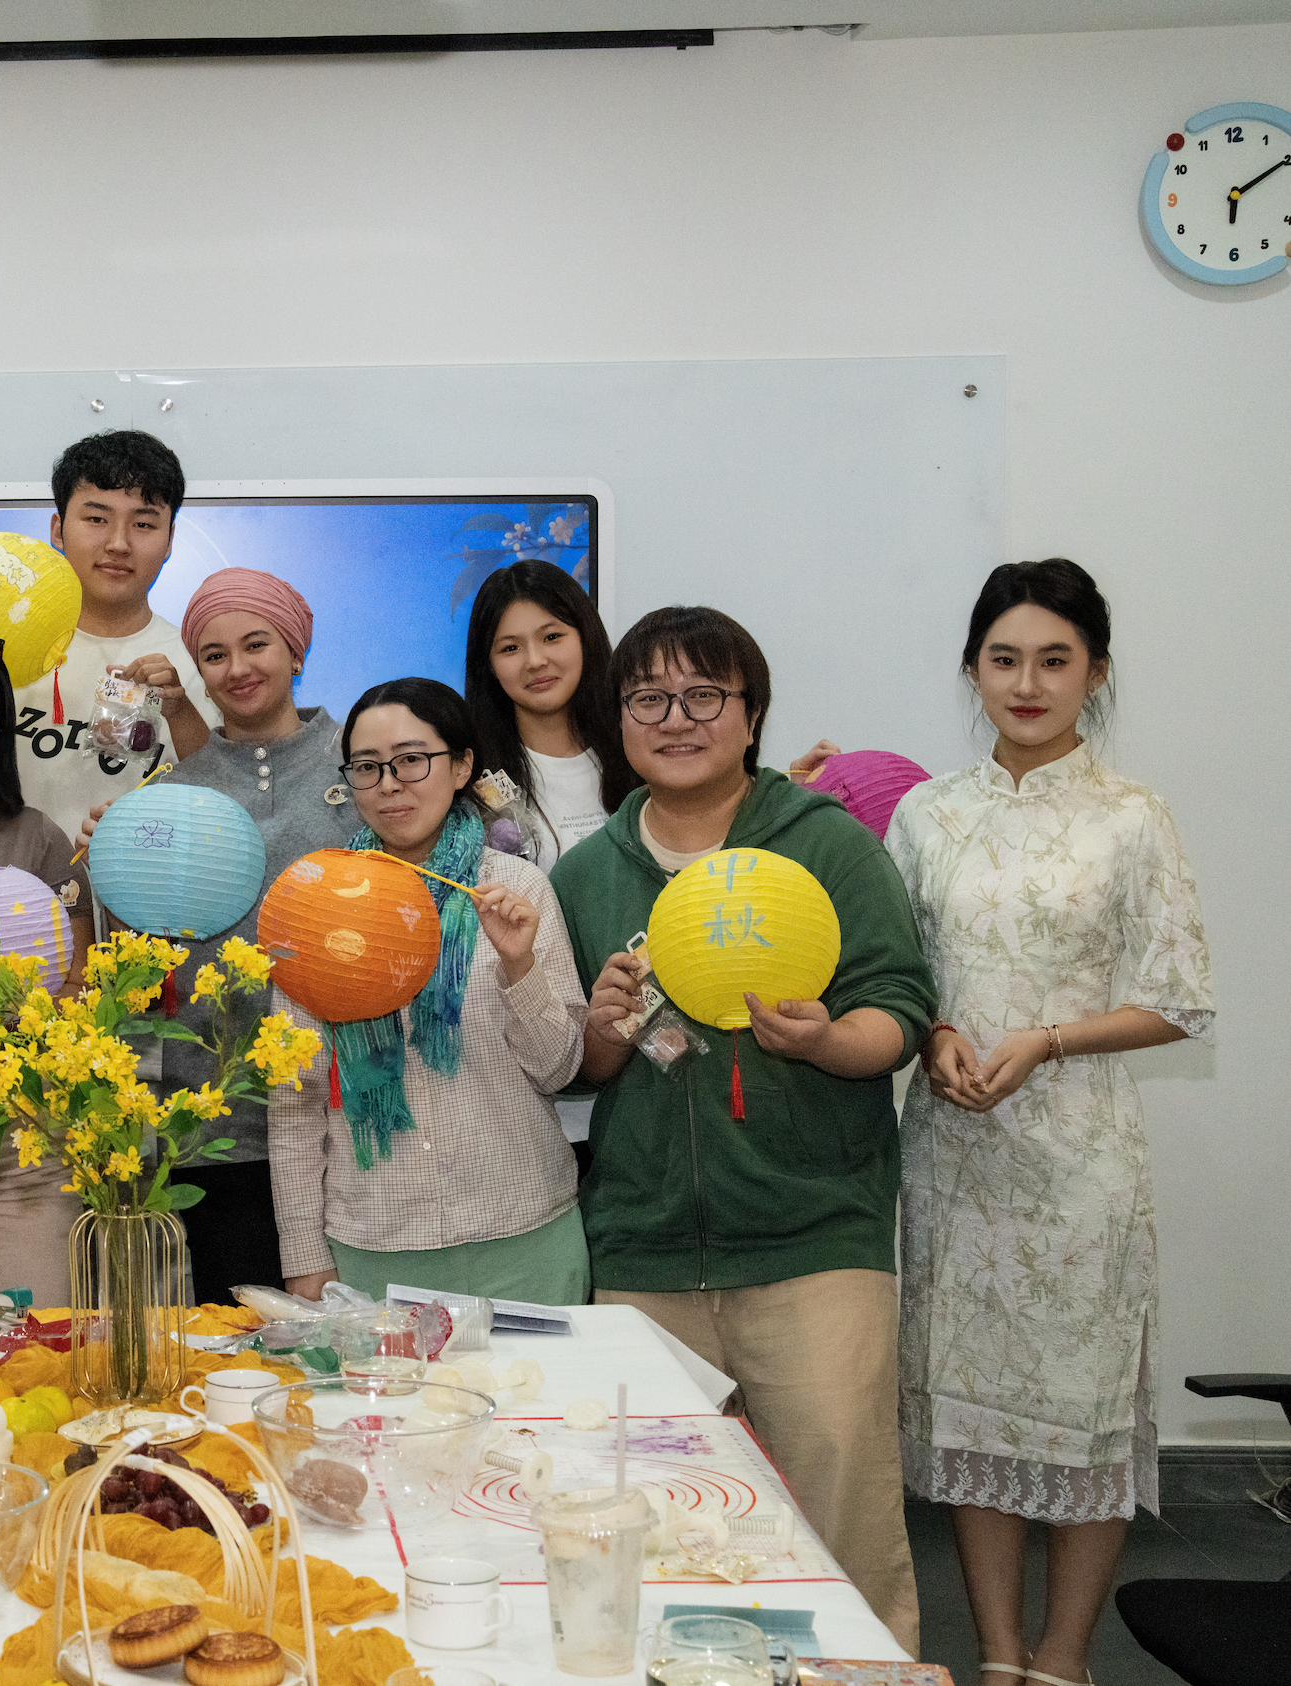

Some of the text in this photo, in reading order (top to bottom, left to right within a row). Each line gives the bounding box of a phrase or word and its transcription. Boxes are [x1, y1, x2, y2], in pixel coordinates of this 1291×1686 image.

[1225, 127, 1244, 143] 12
[1262, 135, 1269, 146] 1
[1198, 140, 1209, 151] 11
[1174, 164, 1188, 175] 10
[1167, 193, 1178, 208] 9
[1177, 224, 1185, 235] 8
[1199, 243, 1208, 255] 7
[1260, 239, 1269, 250] 5
[1228, 247, 1240, 262] 6
[703, 853, 775, 948] 中秋
